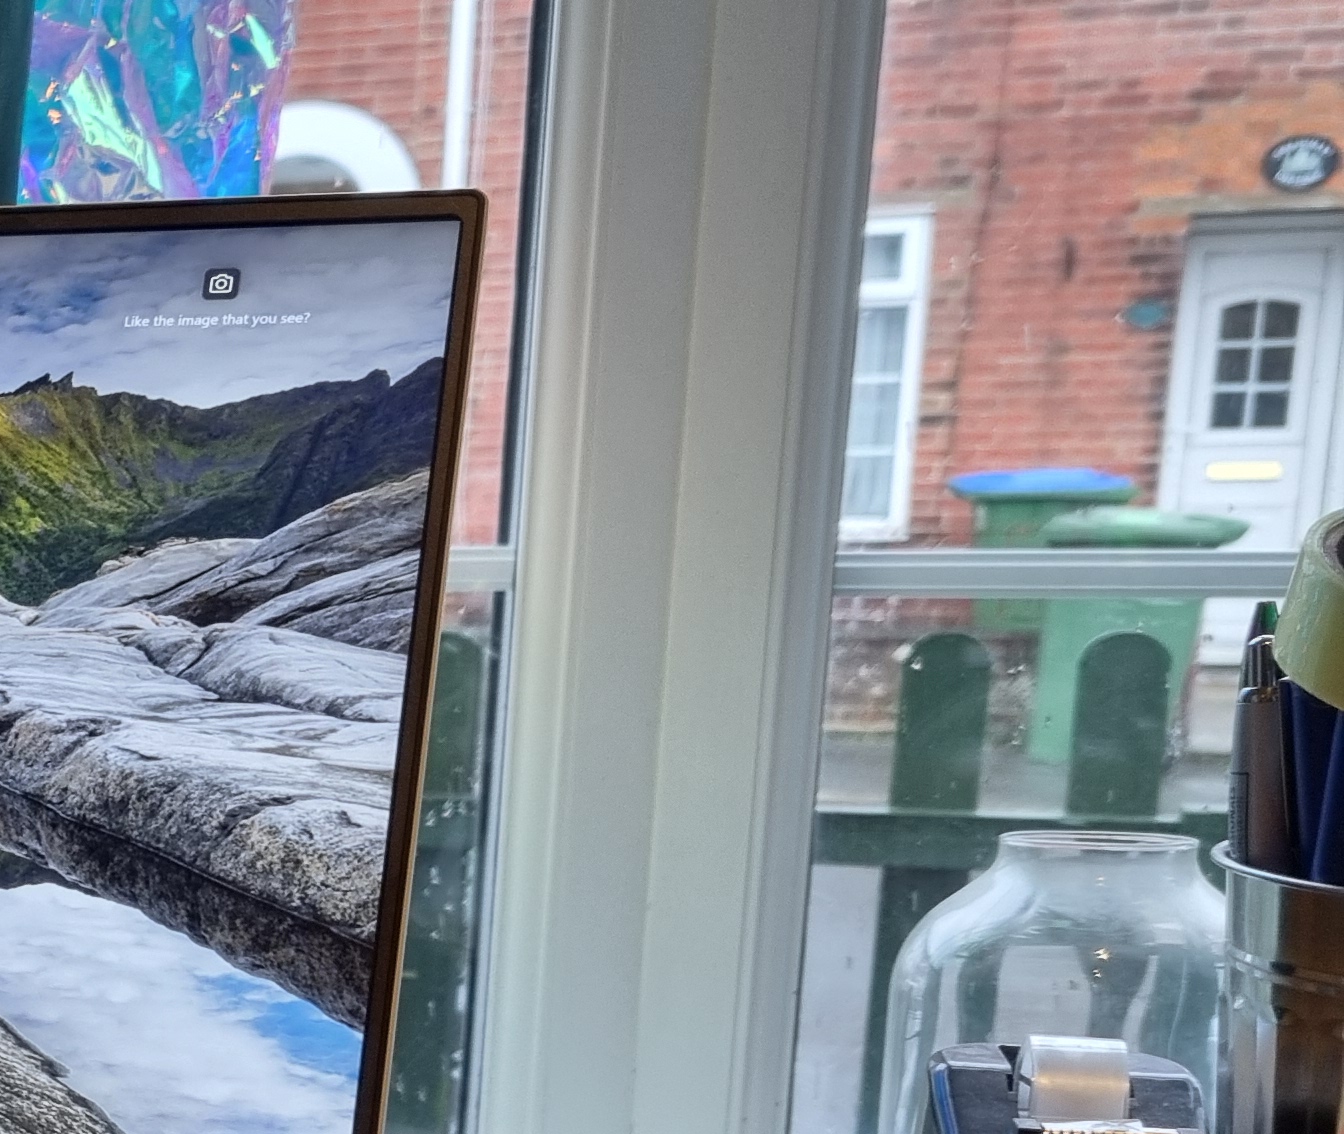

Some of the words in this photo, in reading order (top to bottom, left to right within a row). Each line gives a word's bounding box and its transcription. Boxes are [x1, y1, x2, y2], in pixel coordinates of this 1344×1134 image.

[123, 316, 150, 328] Like
[153, 314, 175, 327] the
[177, 315, 219, 330] image
[222, 313, 249, 326] that
[250, 314, 278, 328] you
[279, 312, 312, 324] see?
